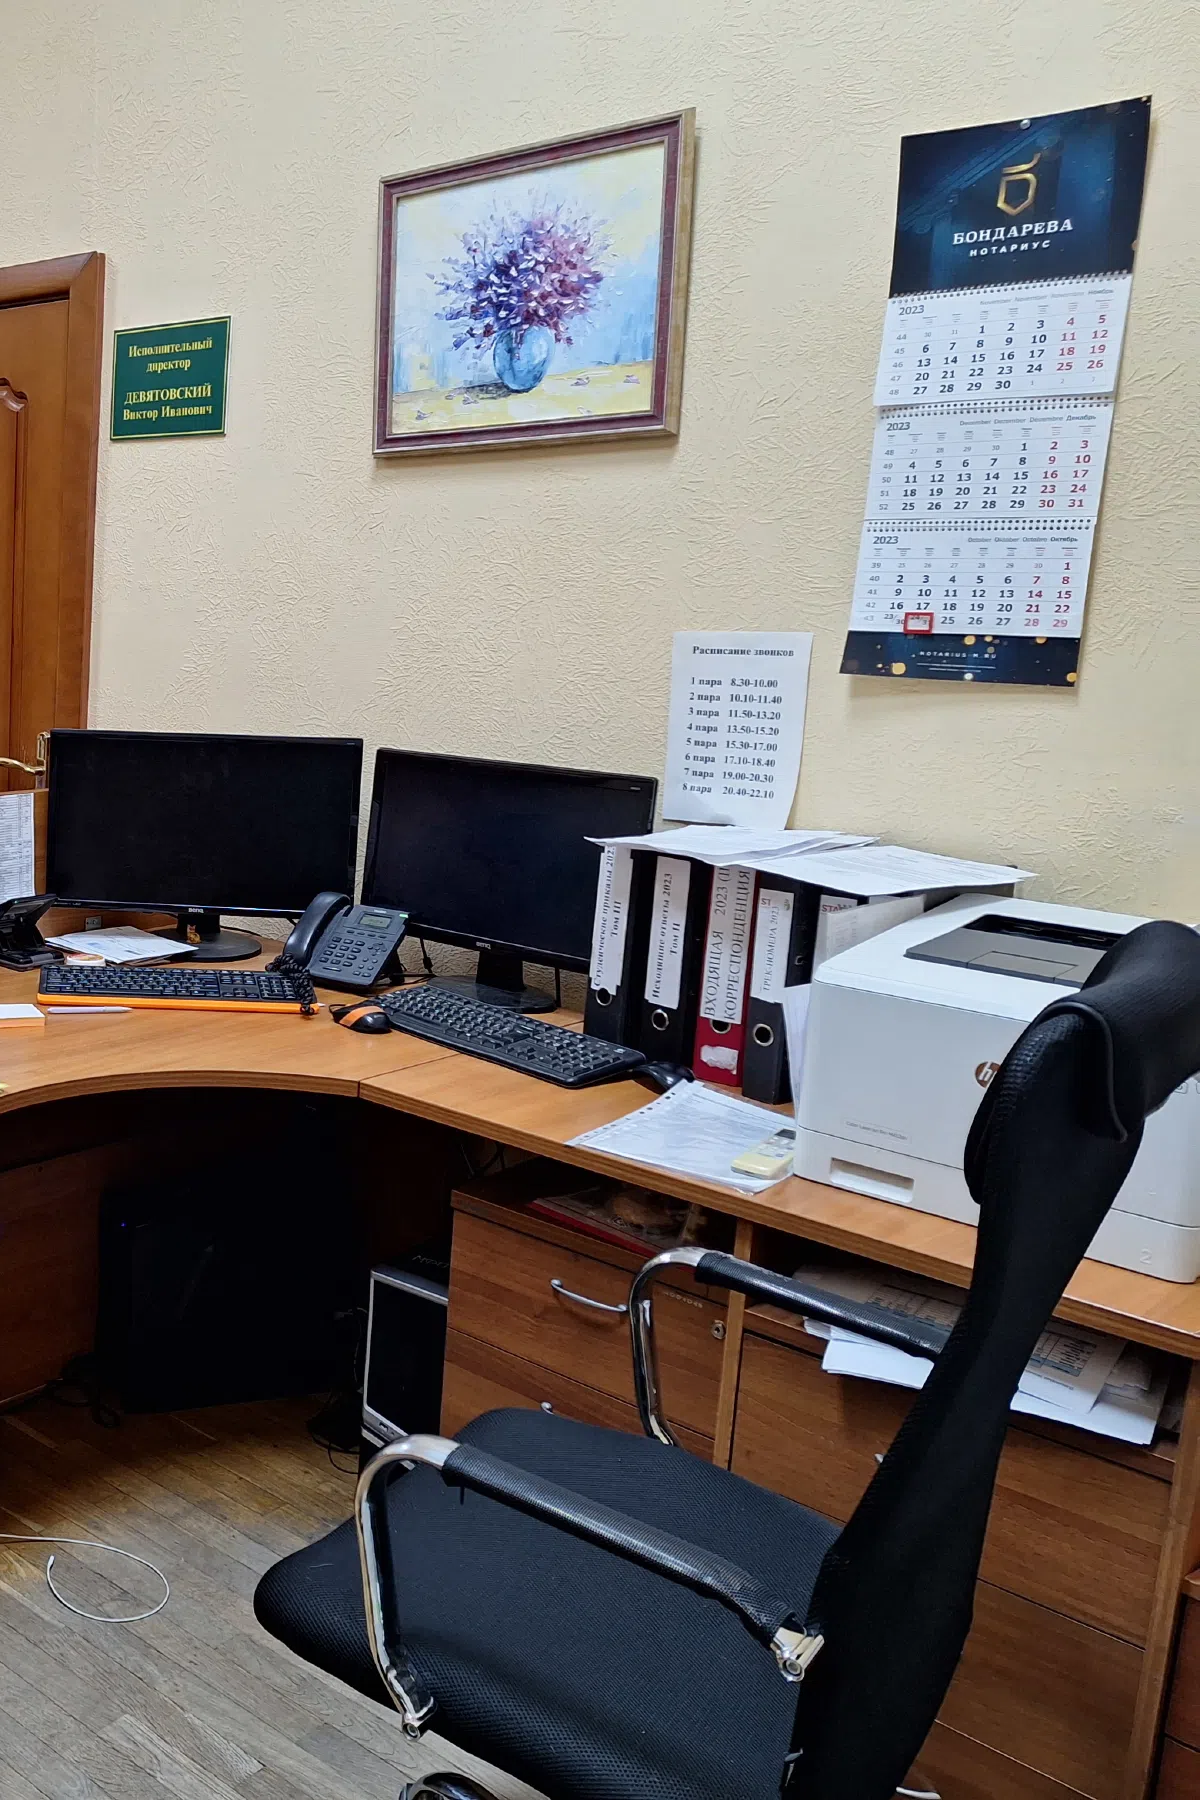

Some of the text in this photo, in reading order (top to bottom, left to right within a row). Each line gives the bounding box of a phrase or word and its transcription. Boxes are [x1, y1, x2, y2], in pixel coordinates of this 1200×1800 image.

[953, 218, 1073, 244] БОНДАРЕВА
[969, 240, 1051, 257] НОТАРИУС
[899, 305, 924, 315] 2023
[979, 314, 1106, 334] 1 2 3 4 5
[129, 337, 212, 357] Исполнительный
[922, 329, 1108, 353] 6 7 8 9 10 11 12
[917, 344, 1106, 367] 13 14 15 16 17 18 19
[146, 359, 191, 373] директор
[915, 359, 1103, 381] 20 21 22 23 24 25 26
[124, 383, 211, 405] ДЕВЯТОВСКИЙ
[124, 405, 212, 421] Виктор Иванович
[886, 422, 910, 431] 2023
[909, 454, 1091, 469] 4 5 6 7 8 9 10
[904, 469, 1089, 483] 11 12 13 14 15 16 17
[903, 484, 1087, 497] 18 19 20 21 22 23 24
[901, 499, 1084, 511] 25 26 27 28 29 30 31
[873, 535, 899, 544] 2023
[896, 574, 1070, 585] 2 3 4 5 6 7 8
[895, 588, 1072, 599] 9 10 11 12 13 14 15
[890, 602, 1070, 613] 16 17 18 19 20 21 22
[693, 645, 794, 657] Расписание звонков
[691, 677, 778, 688] 1 пара 8.30-10.00
[730, 694, 782, 704] 10.10-11.40
[696, 710, 719, 718] пара
[728, 709, 781, 720] 11.50-13.20
[695, 725, 718, 733] пара
[727, 725, 779, 736] 13.50-15.20
[686, 738, 777, 752] 5 пара 15.30-17.00
[693, 756, 715, 764] пара
[724, 756, 775, 767] 17.10-18.40
[692, 771, 714, 779] пара
[723, 771, 773, 783] 19.00-20.30
[682, 783, 774, 799] 8 пара 20.40-22.10
[610, 899, 622, 938] Том III
[593, 916, 608, 987] Студенческие
[603, 869, 613, 915] приказы
[652, 872, 673, 998] Исходящие ответы 2023
[669, 922, 681, 956] Том II
[724, 870, 750, 1021] КОРРЕСПОНДЕНЦИЯ
[704, 930, 724, 1017] ВХОДЯЩАЯ
[714, 886, 728, 916] 2023
[763, 906, 780, 991] ТРЕК-НОМЕРА 2023
[1139, 1248, 1153, 1265] 2
